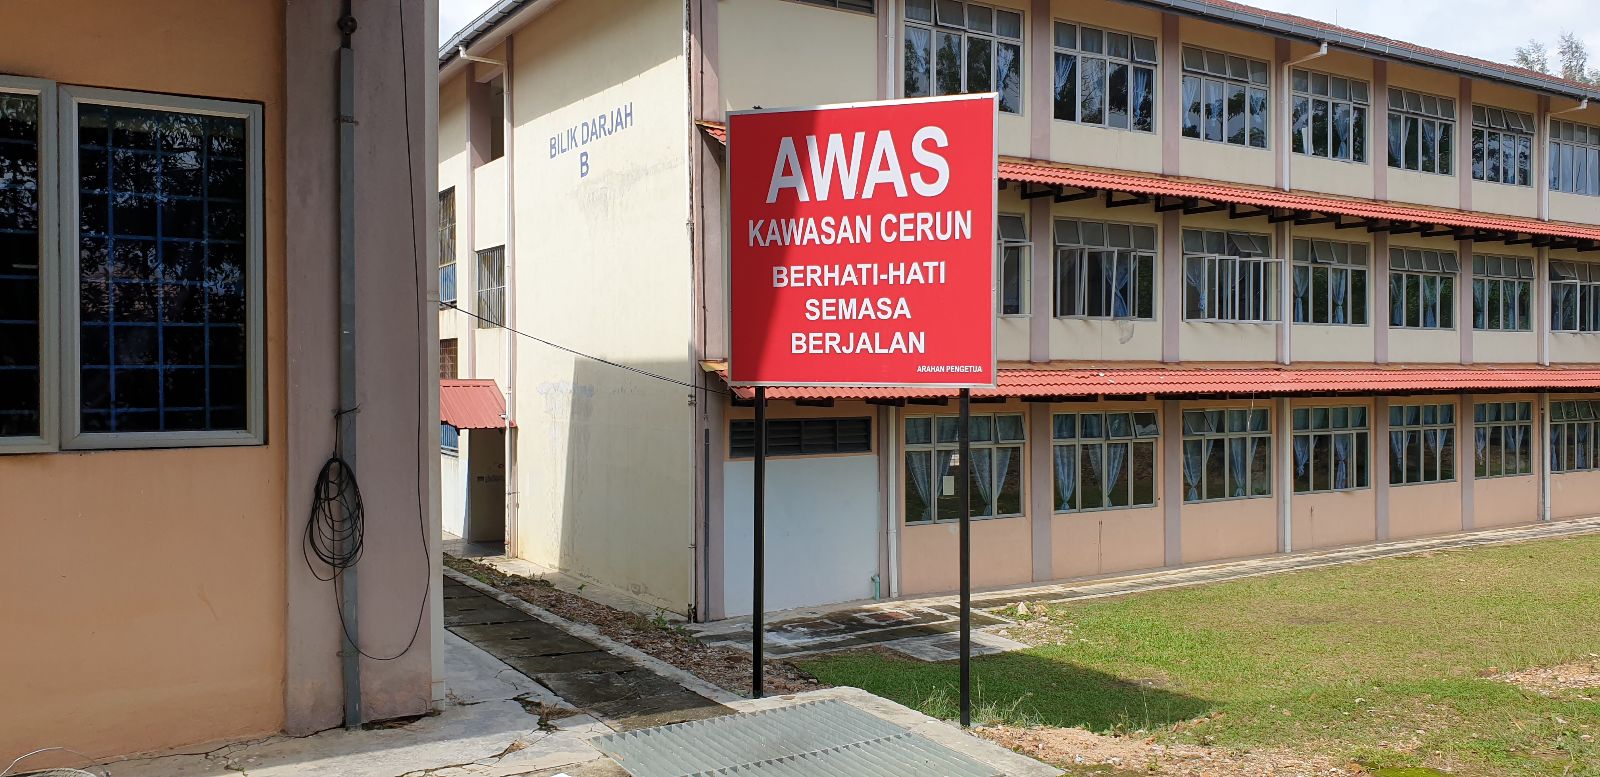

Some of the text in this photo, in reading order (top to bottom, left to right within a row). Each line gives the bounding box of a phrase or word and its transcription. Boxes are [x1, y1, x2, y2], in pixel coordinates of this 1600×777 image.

[549, 102, 633, 159] BILIK DARJAH
[579, 151, 589, 178] B
[766, 125, 950, 204] AWAS
[748, 210, 972, 247] KAWASAN CERUN
[772, 260, 946, 288] BERHATI-HATI
[804, 297, 912, 321] SEMASA
[791, 331, 925, 354] BERJALAN
[916, 365, 983, 373] ARAHAN PENGETUA
